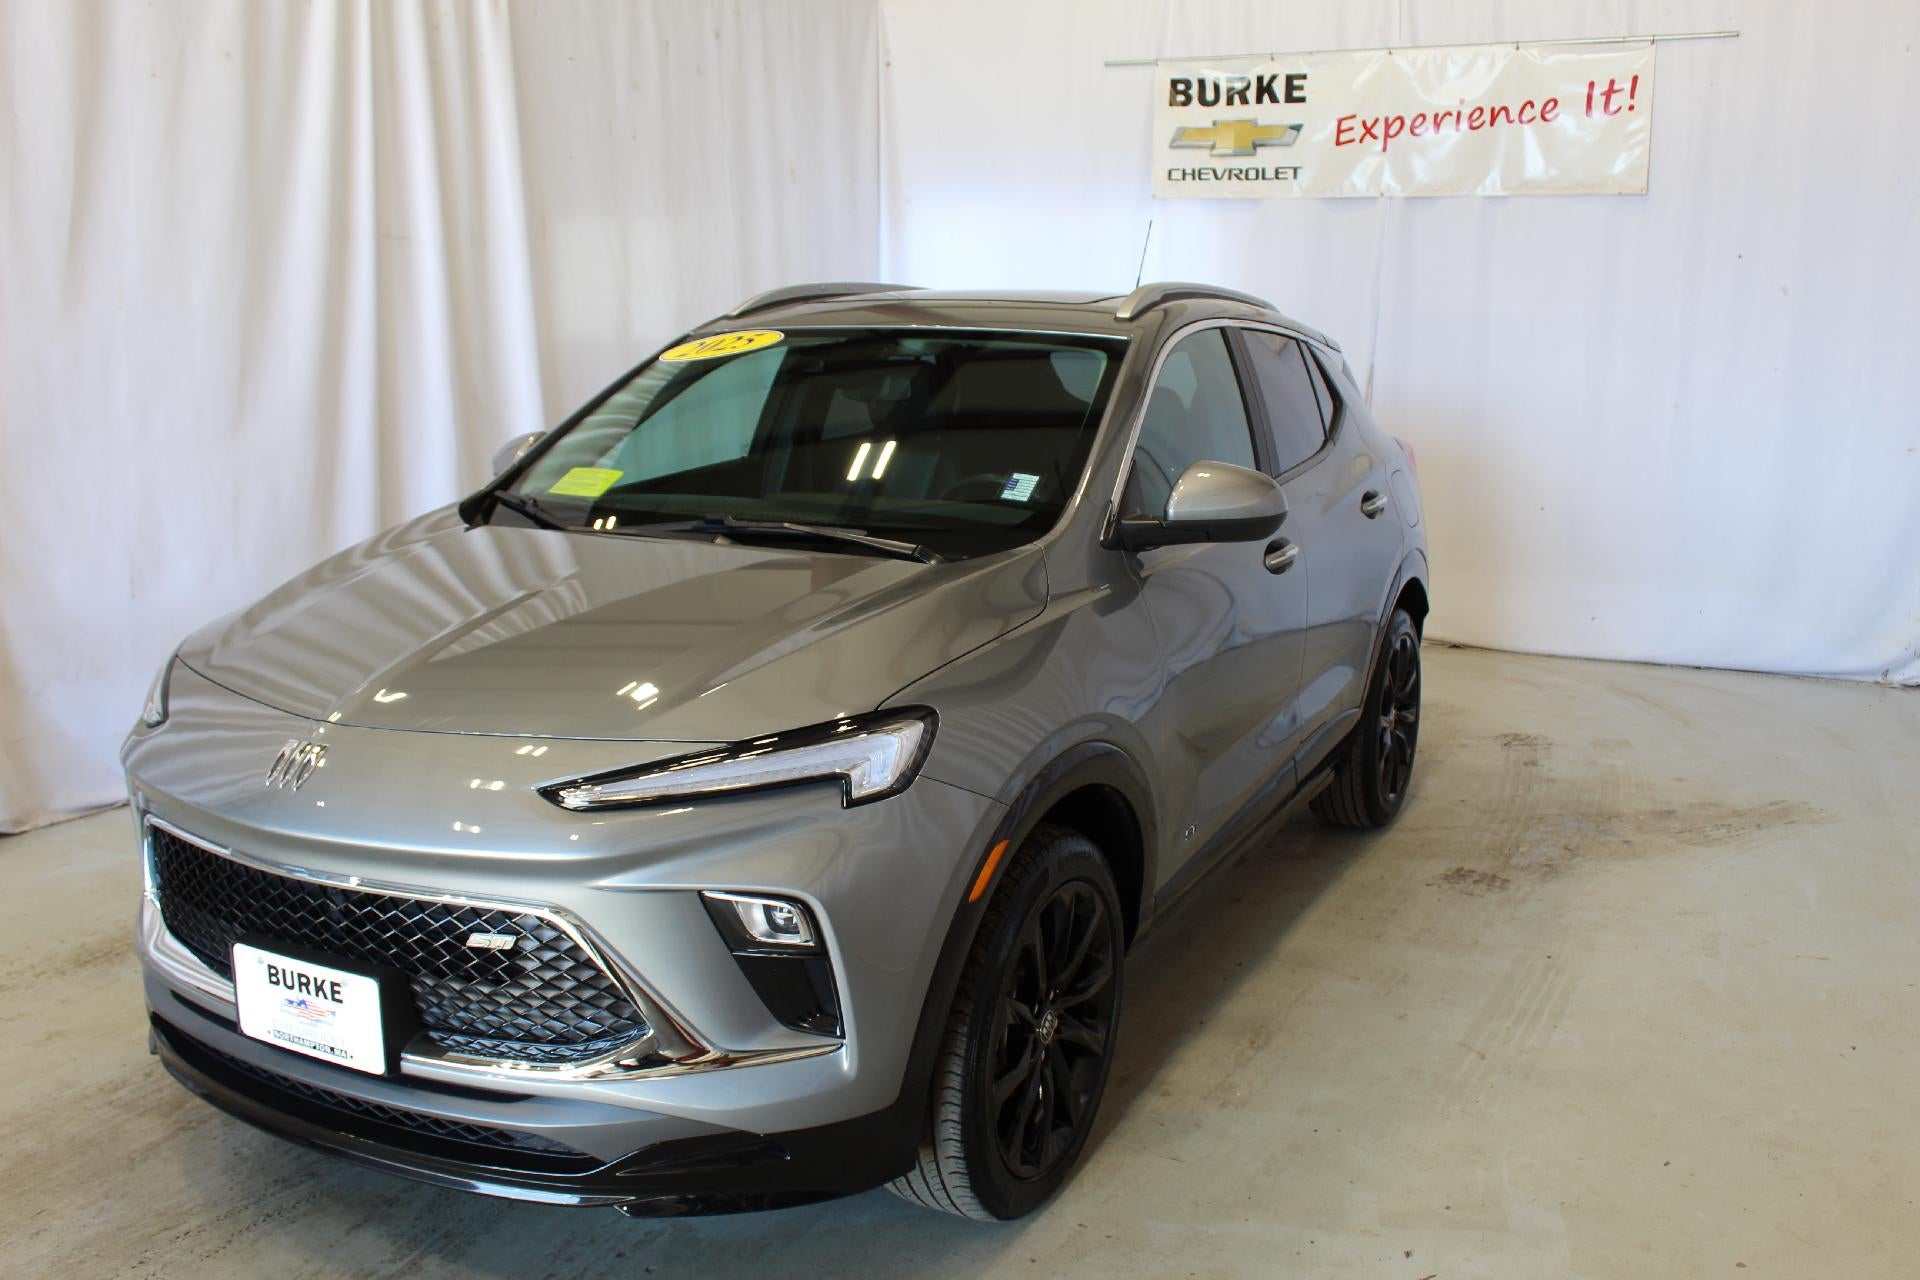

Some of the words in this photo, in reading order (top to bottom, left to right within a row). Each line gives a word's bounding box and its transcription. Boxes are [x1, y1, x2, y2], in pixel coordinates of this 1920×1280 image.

[1168, 73, 1308, 107] BURKE
[1335, 97, 1560, 153] Experience
[1585, 73, 1639, 118] It!
[1167, 165, 1304, 182] CHEVROLET
[671, 332, 768, 358] 2025
[267, 963, 344, 1004] BURKE
